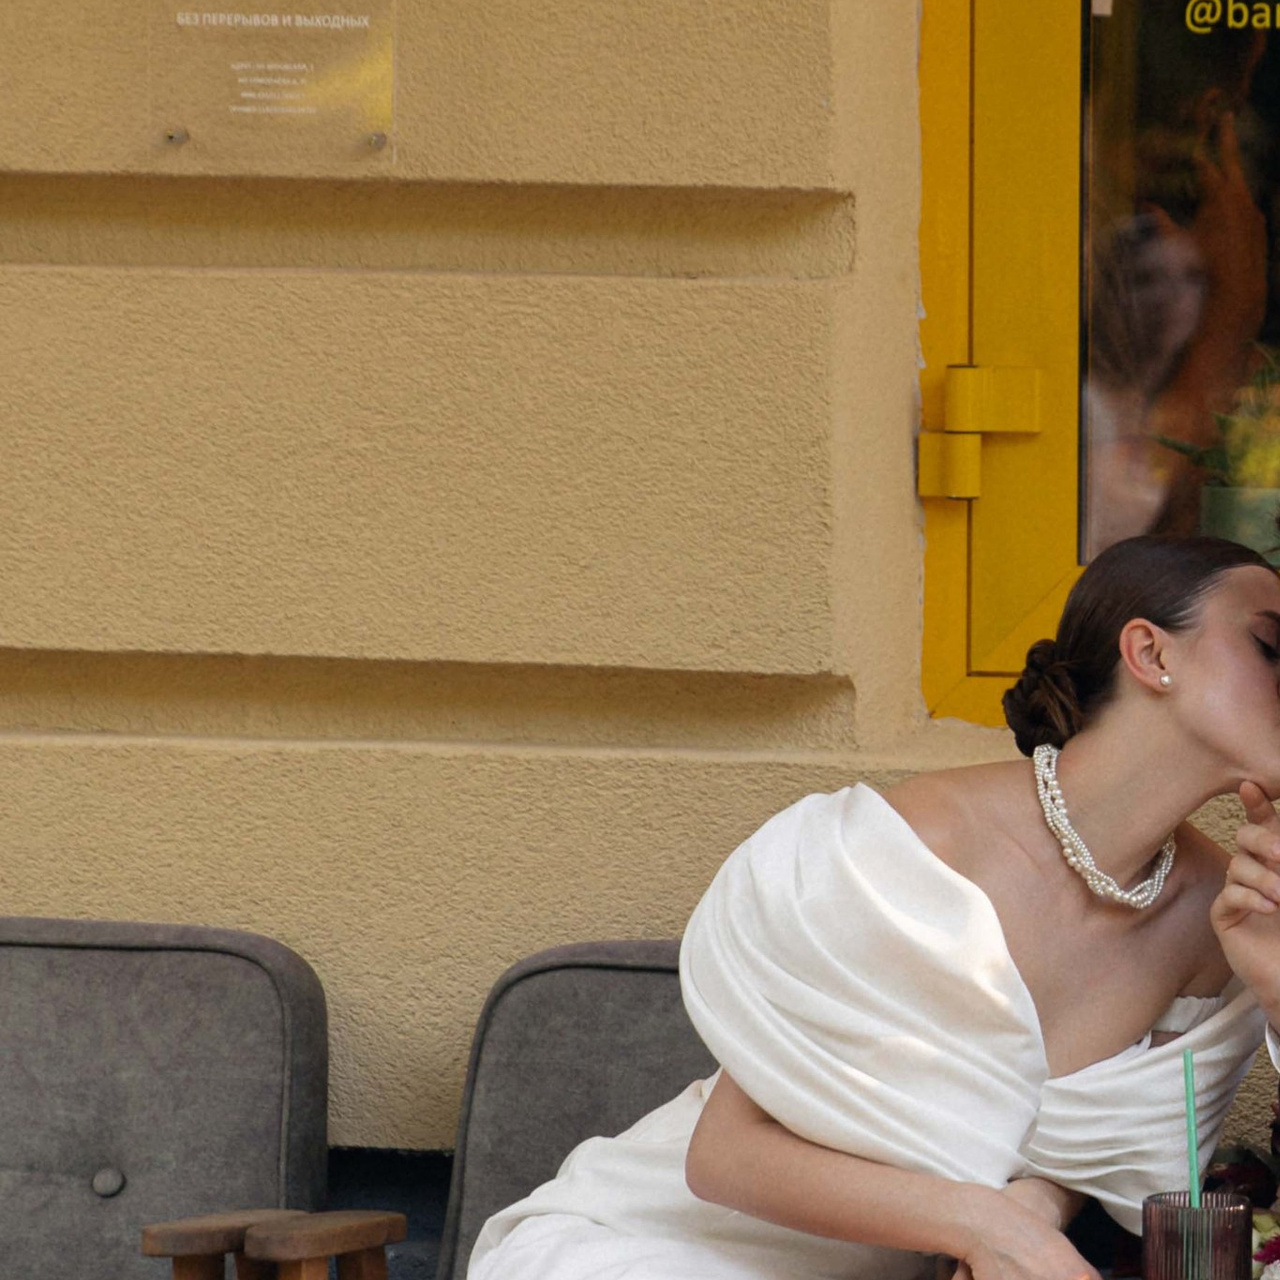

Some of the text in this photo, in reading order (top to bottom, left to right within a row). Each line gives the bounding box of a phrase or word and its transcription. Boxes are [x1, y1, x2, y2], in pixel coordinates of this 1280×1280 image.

[176, 11, 199, 26] БЕЗ
[202, 12, 278, 28] ПЕРЕРЫВОВ
[295, 14, 371, 31] ВЫХОДНЫХ
